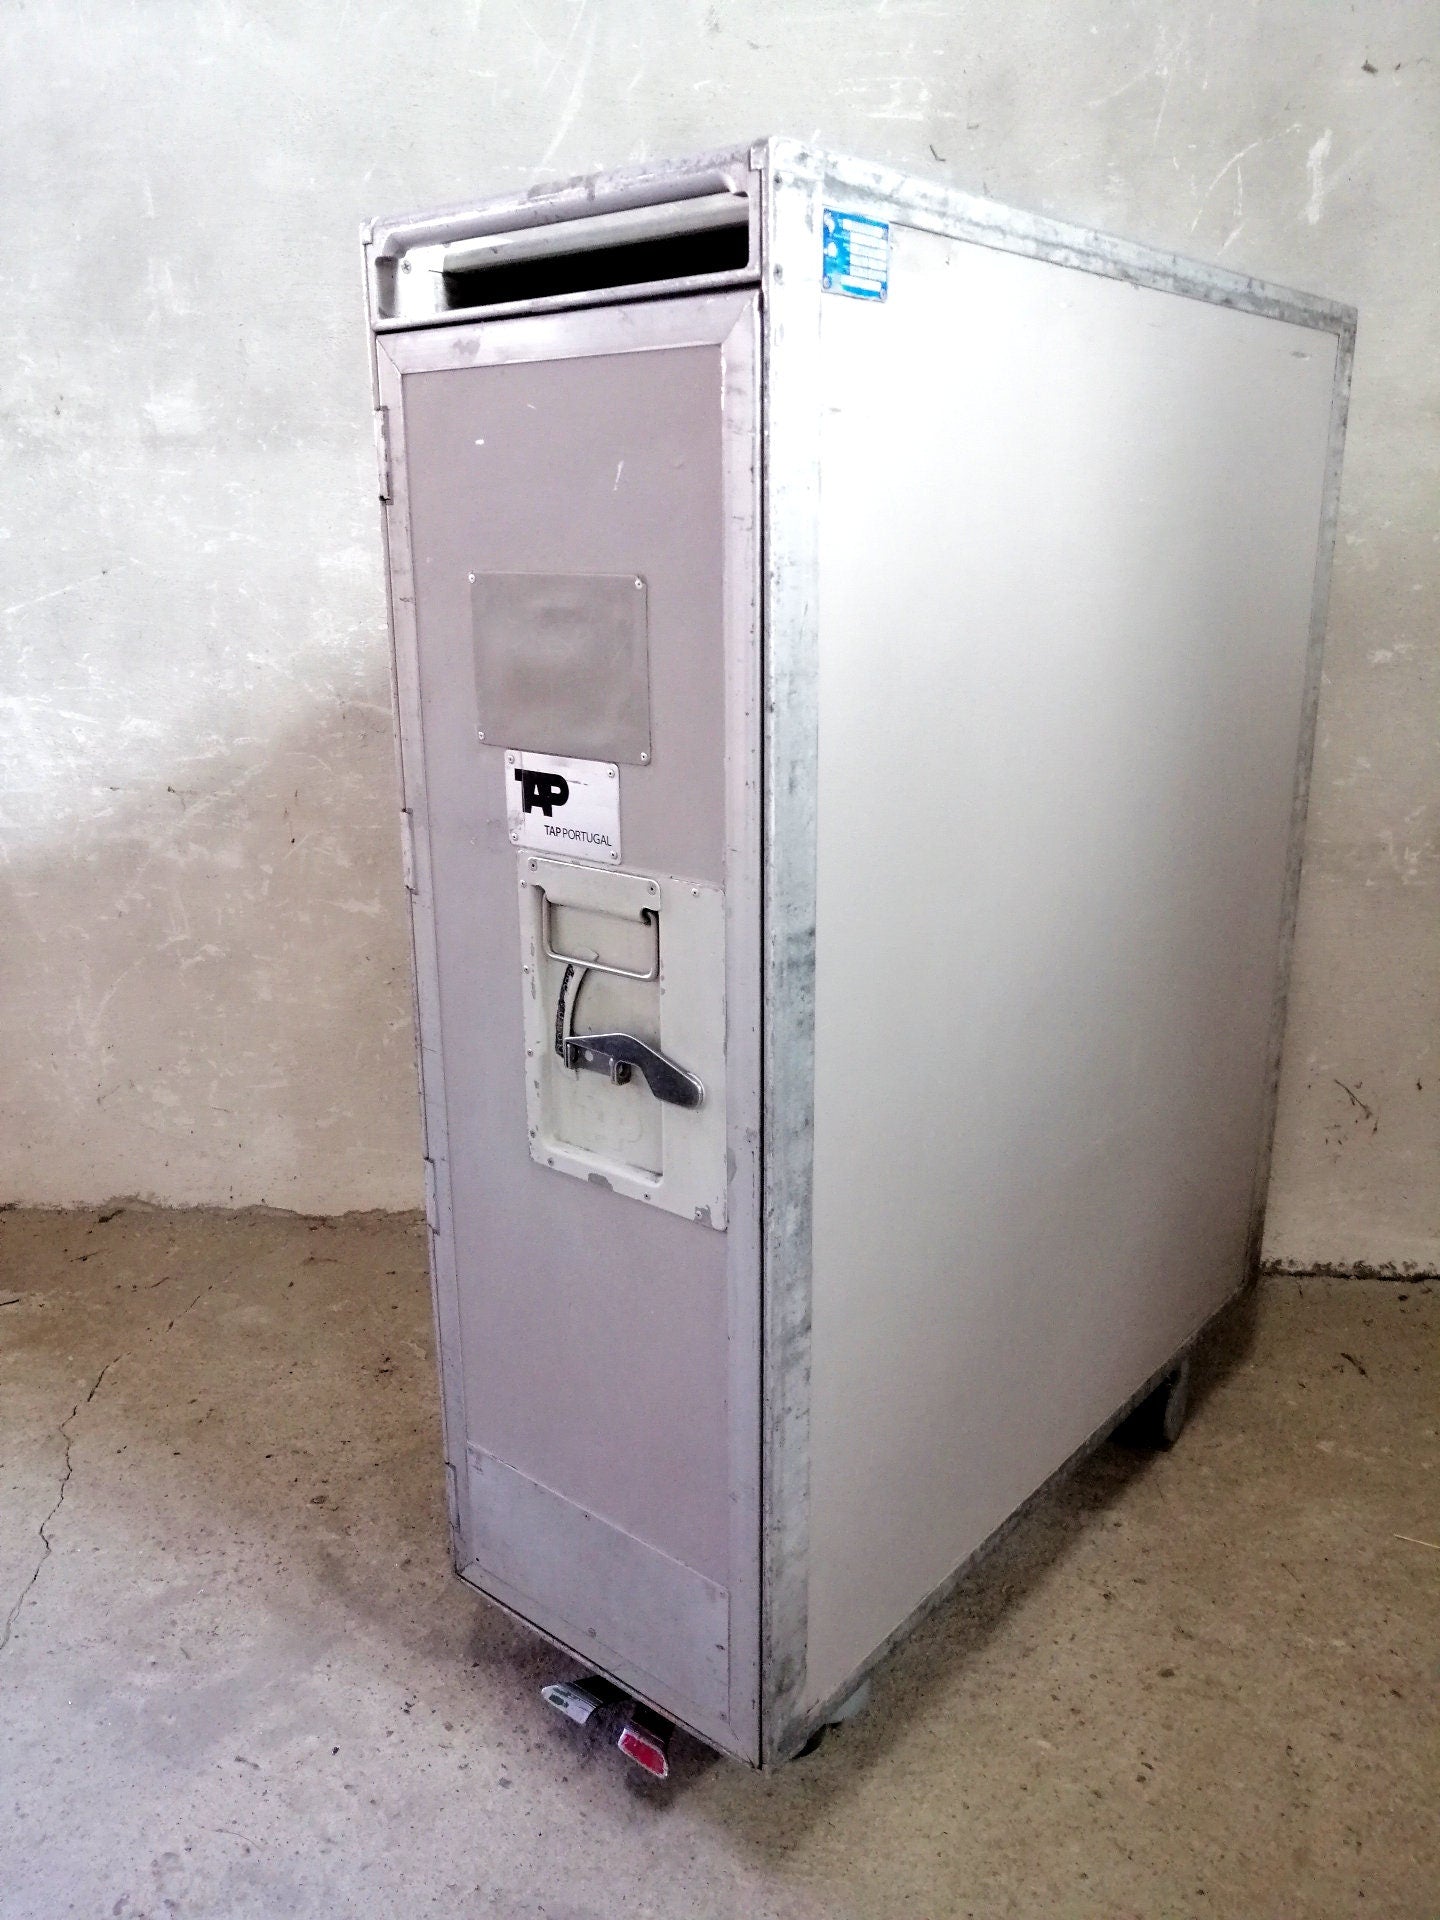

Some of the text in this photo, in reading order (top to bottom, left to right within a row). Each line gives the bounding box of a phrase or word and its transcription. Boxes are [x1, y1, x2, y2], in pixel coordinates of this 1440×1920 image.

[515, 768, 569, 817] TAP
[544, 825, 612, 846] TAP PORTUGAL
